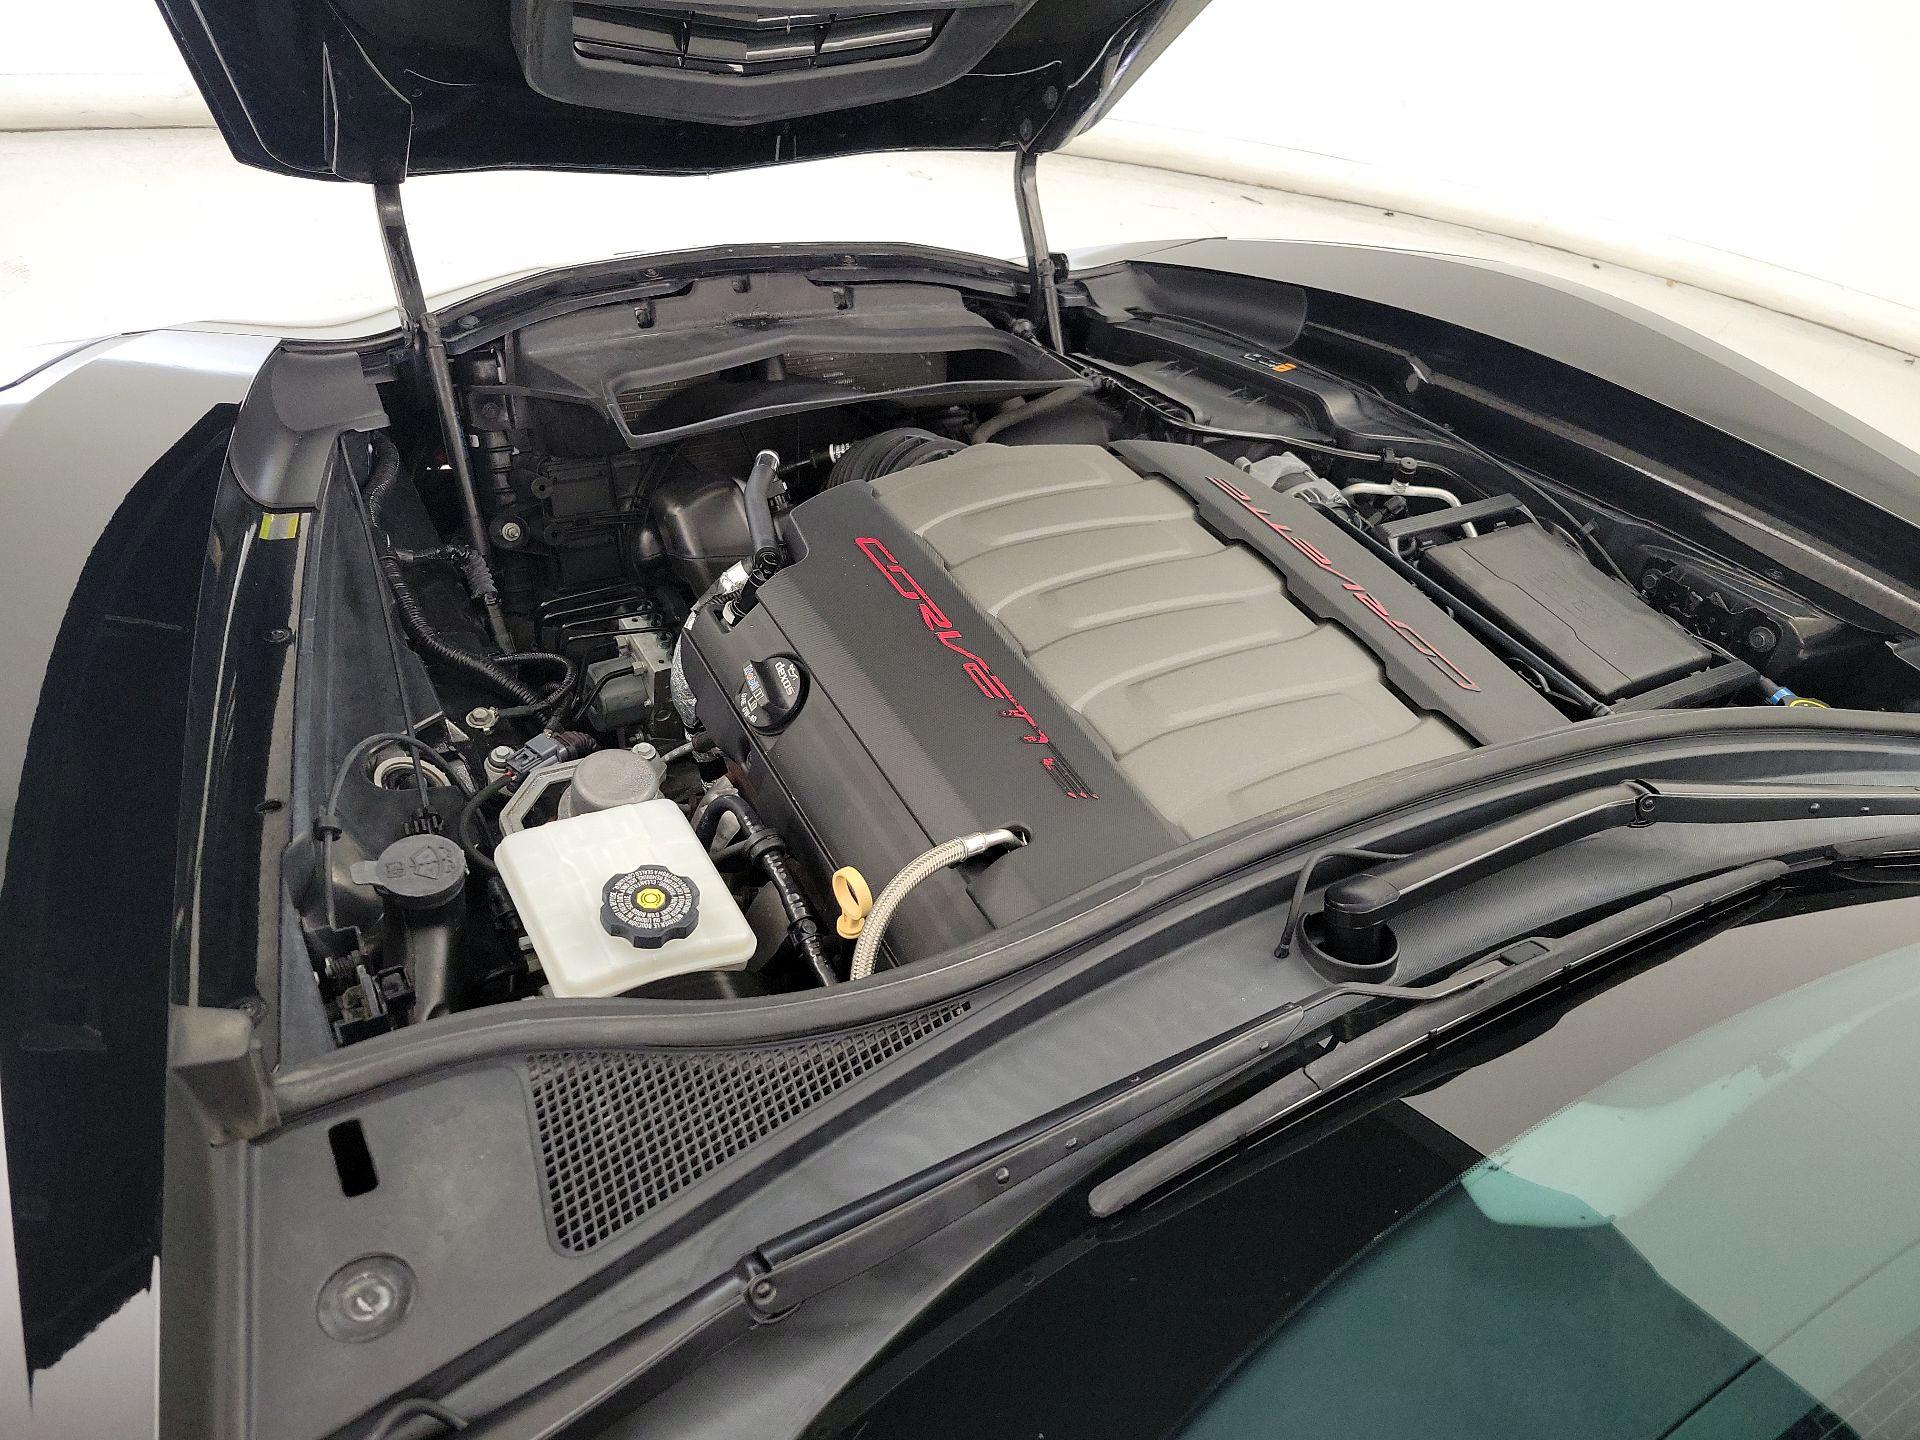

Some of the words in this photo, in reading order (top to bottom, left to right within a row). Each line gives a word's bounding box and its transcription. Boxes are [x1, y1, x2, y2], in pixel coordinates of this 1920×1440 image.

[775, 661, 795, 696] dexos
[853, 537, 1099, 799] CORVETTE
[1205, 476, 1481, 692] CORVETTE
